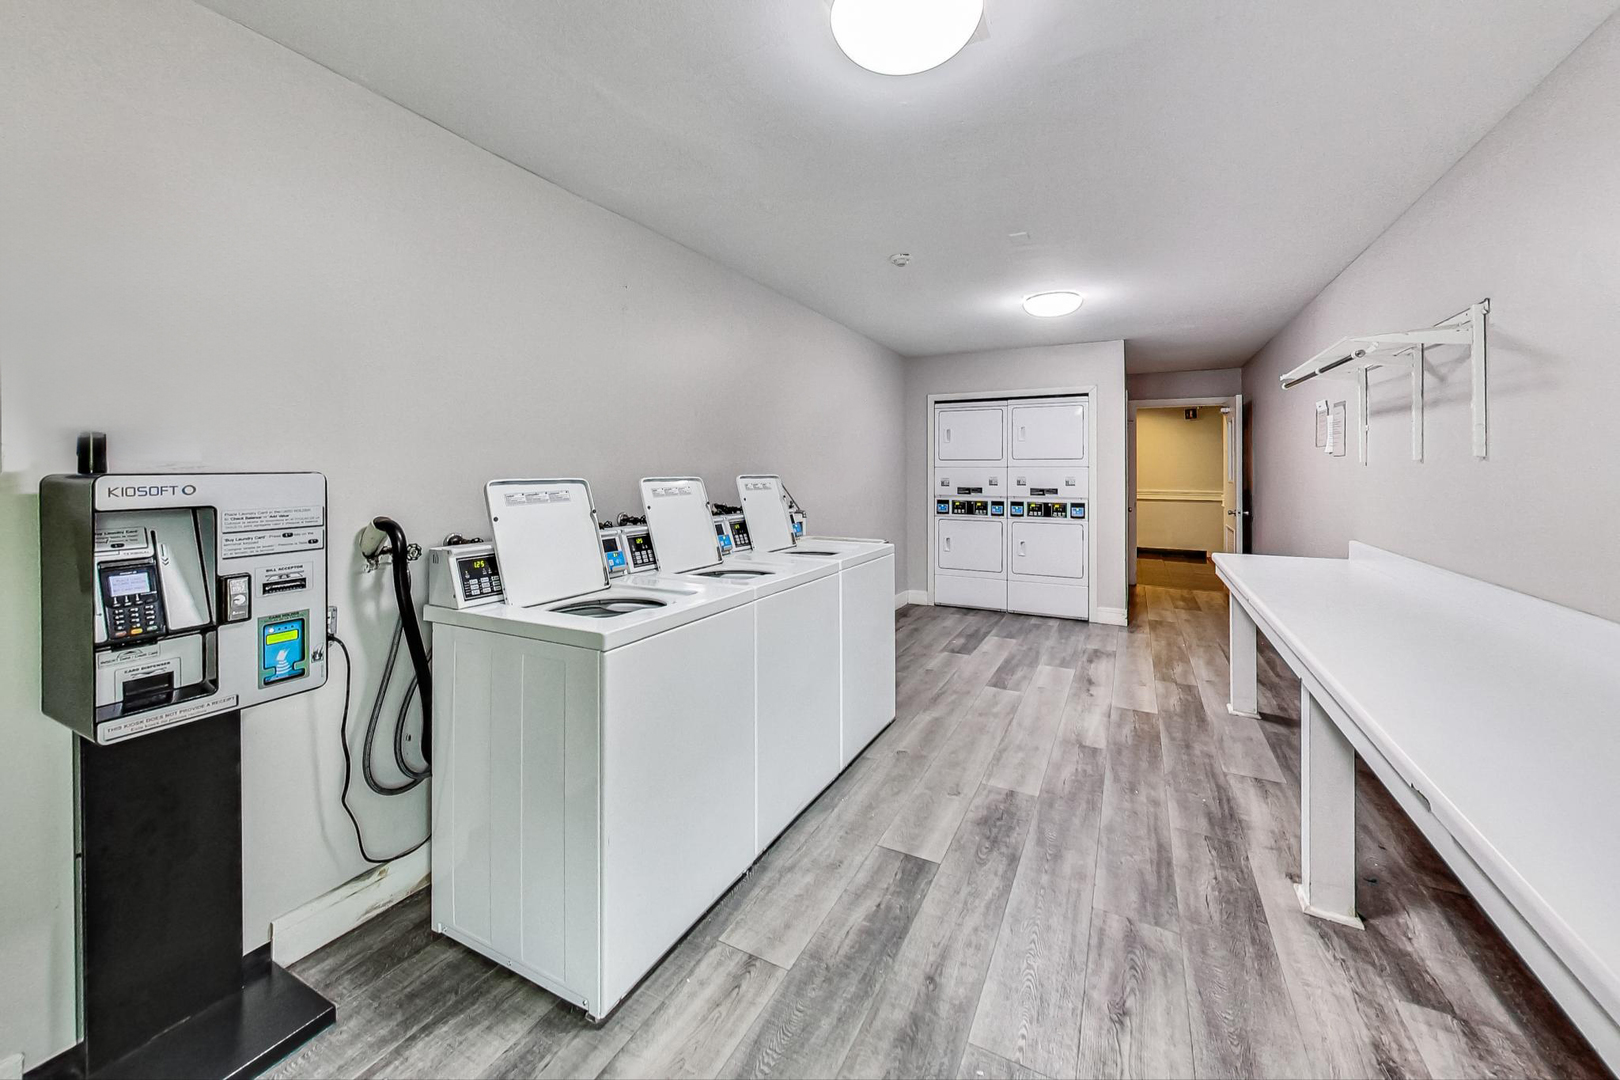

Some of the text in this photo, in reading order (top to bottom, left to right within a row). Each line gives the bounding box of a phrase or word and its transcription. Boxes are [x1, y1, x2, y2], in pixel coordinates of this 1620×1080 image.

[108, 486, 178, 498] KIOSOFT
[141, 661, 171, 671] DISPENSER
[107, 725, 122, 733] THIS
[123, 719, 144, 730] KIOSK
[145, 715, 164, 723] DOES
[164, 711, 178, 719] NOT
[179, 704, 205, 714] PROVIDE
[211, 696, 235, 706] RECEIPT
